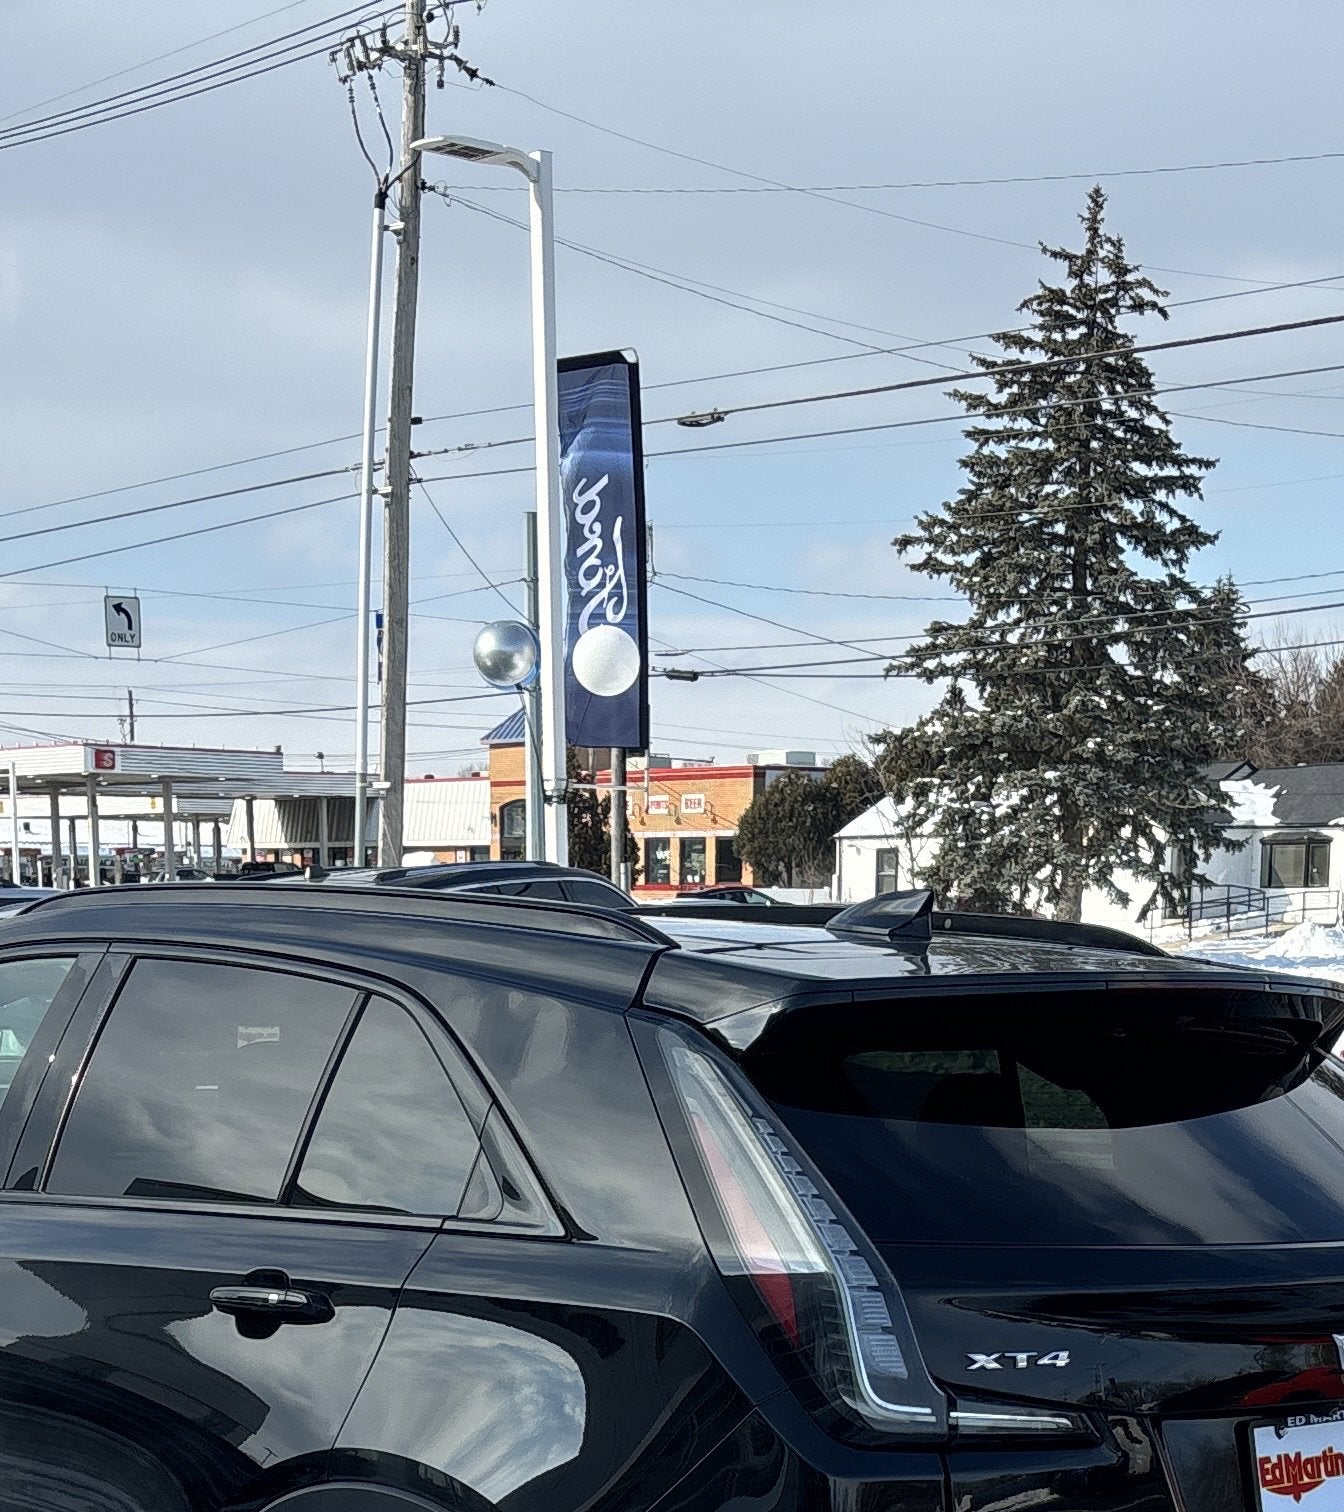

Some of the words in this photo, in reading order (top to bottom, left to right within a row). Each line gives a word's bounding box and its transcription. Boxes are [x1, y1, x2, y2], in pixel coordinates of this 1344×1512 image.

[110, 631, 136, 643] ONLY
[965, 1350, 1071, 1370] XT4
[1287, 1415, 1306, 1427] ED
